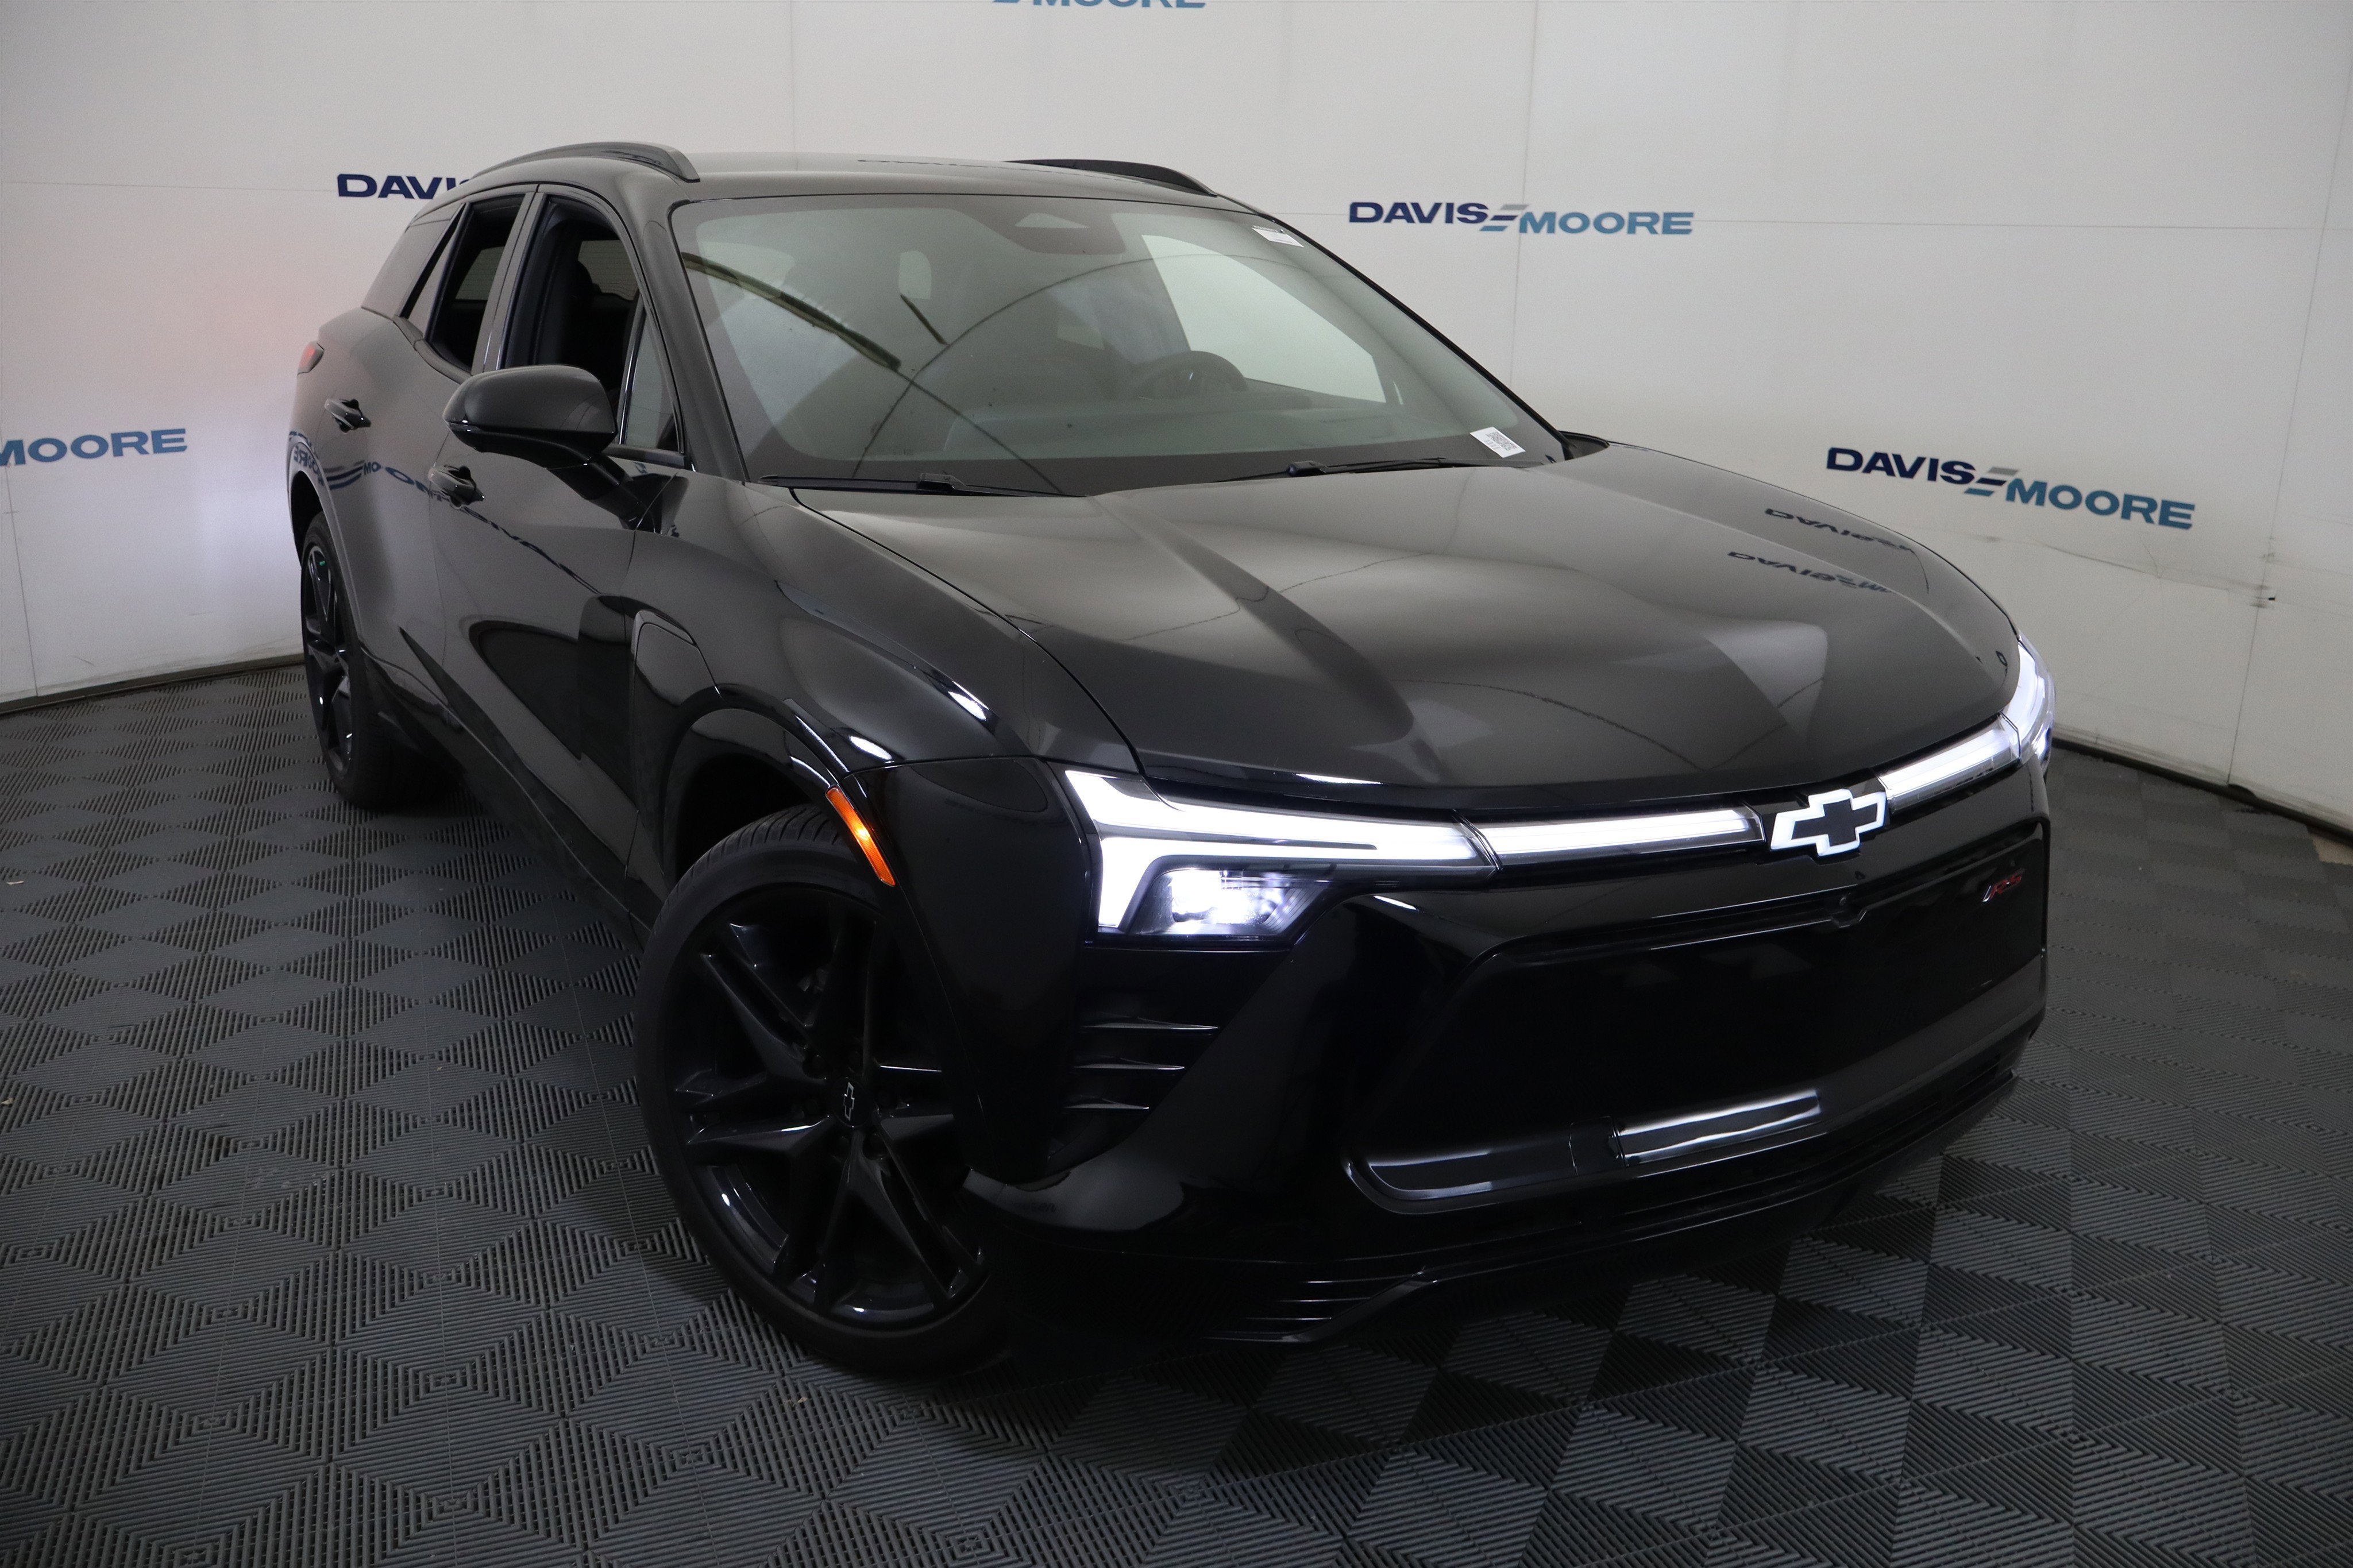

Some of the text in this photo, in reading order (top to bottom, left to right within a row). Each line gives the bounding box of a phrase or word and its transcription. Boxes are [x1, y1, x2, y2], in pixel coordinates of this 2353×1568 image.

[337, 173, 470, 199] DAV
[1349, 202, 1694, 235] DAVIS MOORE
[0, 428, 187, 466] MOORE
[1826, 447, 2195, 530] DAVIS MOORE
